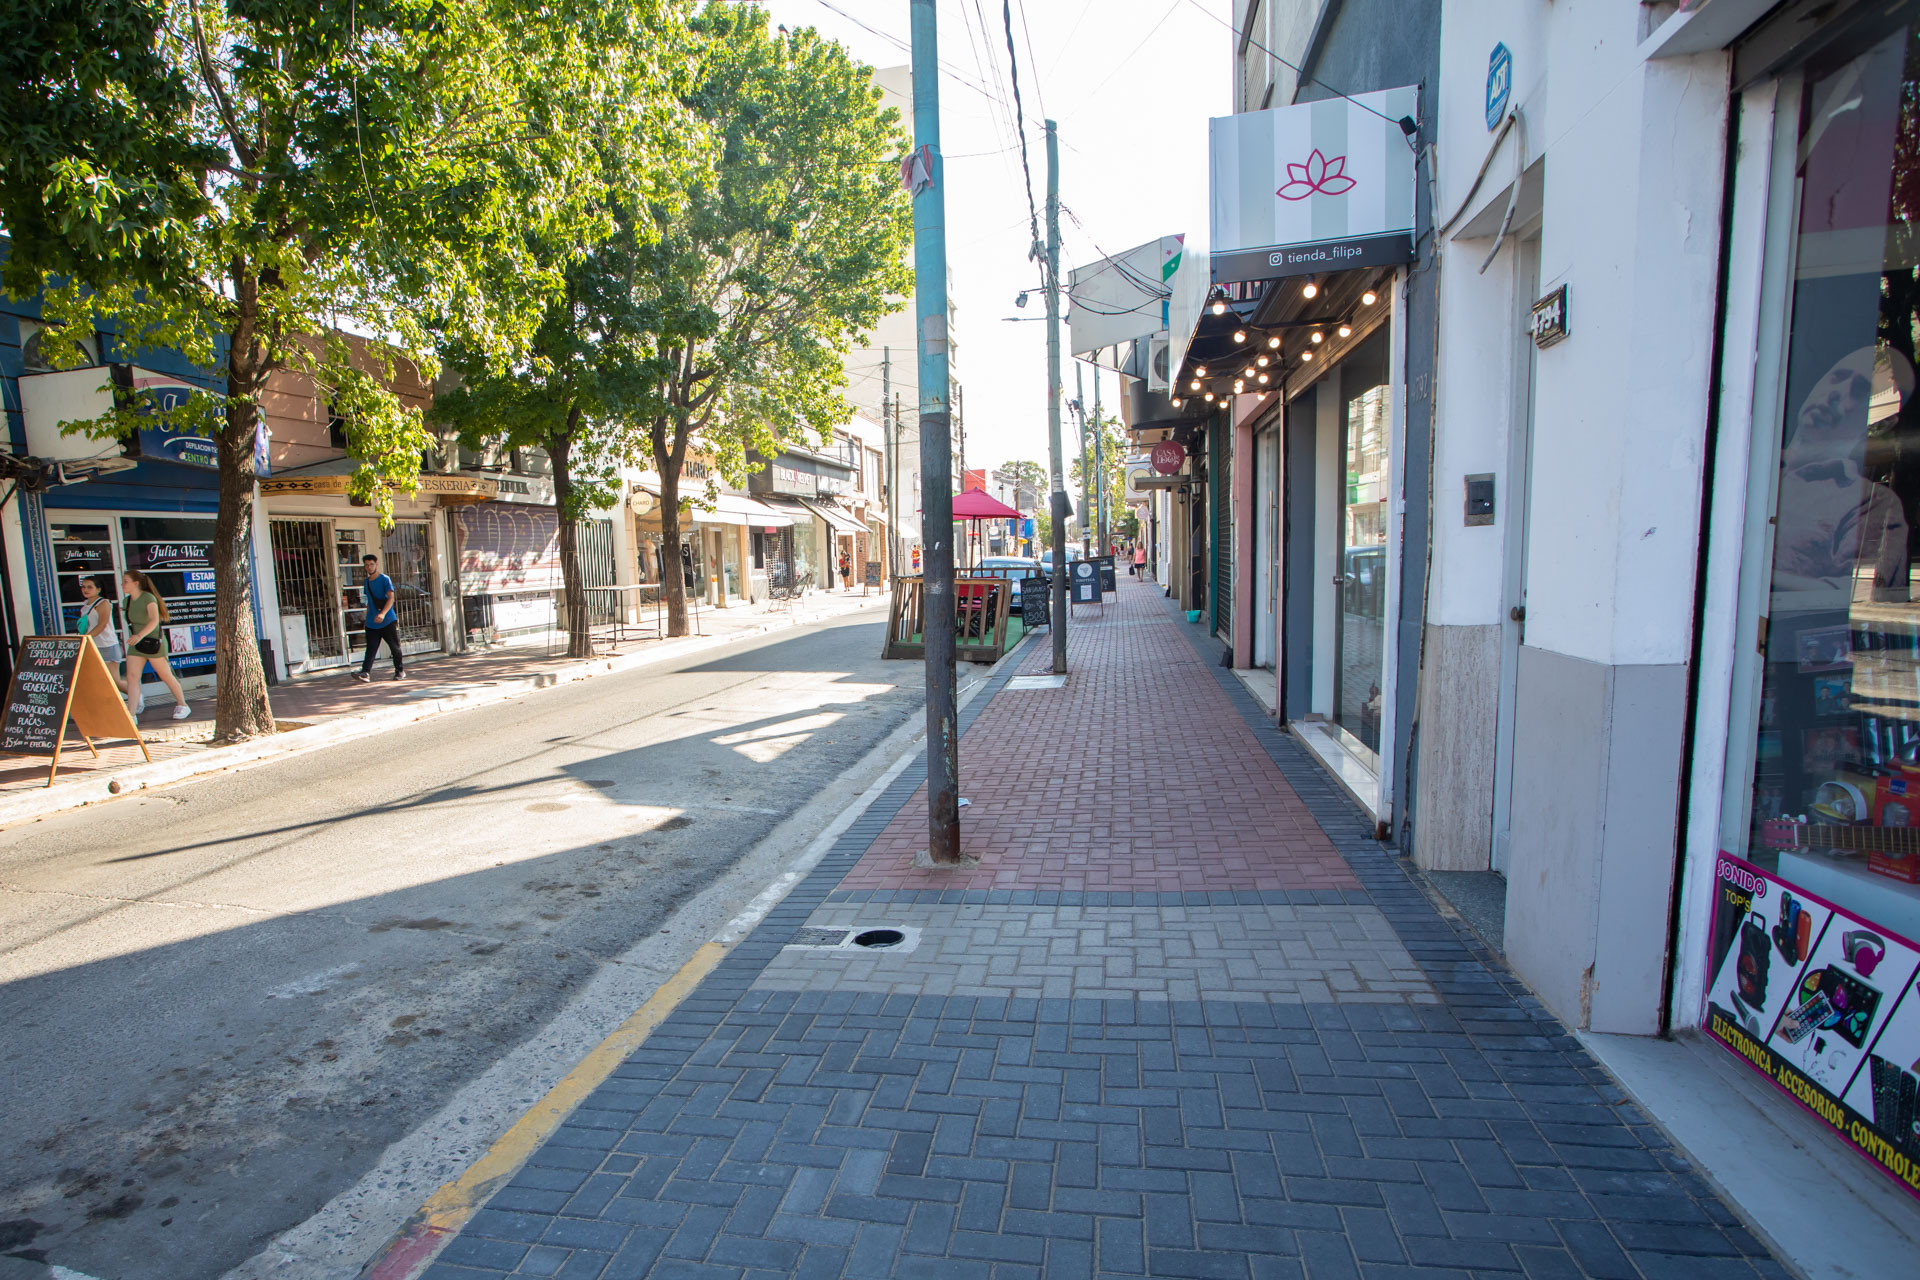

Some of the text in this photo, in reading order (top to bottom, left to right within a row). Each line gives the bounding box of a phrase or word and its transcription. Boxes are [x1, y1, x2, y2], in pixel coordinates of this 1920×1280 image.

[1489, 60, 1508, 105] ADT
[1288, 246, 1362, 264] tienda_filipa
[1531, 299, 1560, 336] 4794
[65, 550, 99, 560] Julia Wax
[148, 544, 206, 562] Julia Wax
[1717, 859, 1767, 898] SONIDO
[1725, 888, 1752, 913] TOP'S
[1712, 1014, 1920, 1191] ELECTRONICA ACCESORIOS CONTROLE
